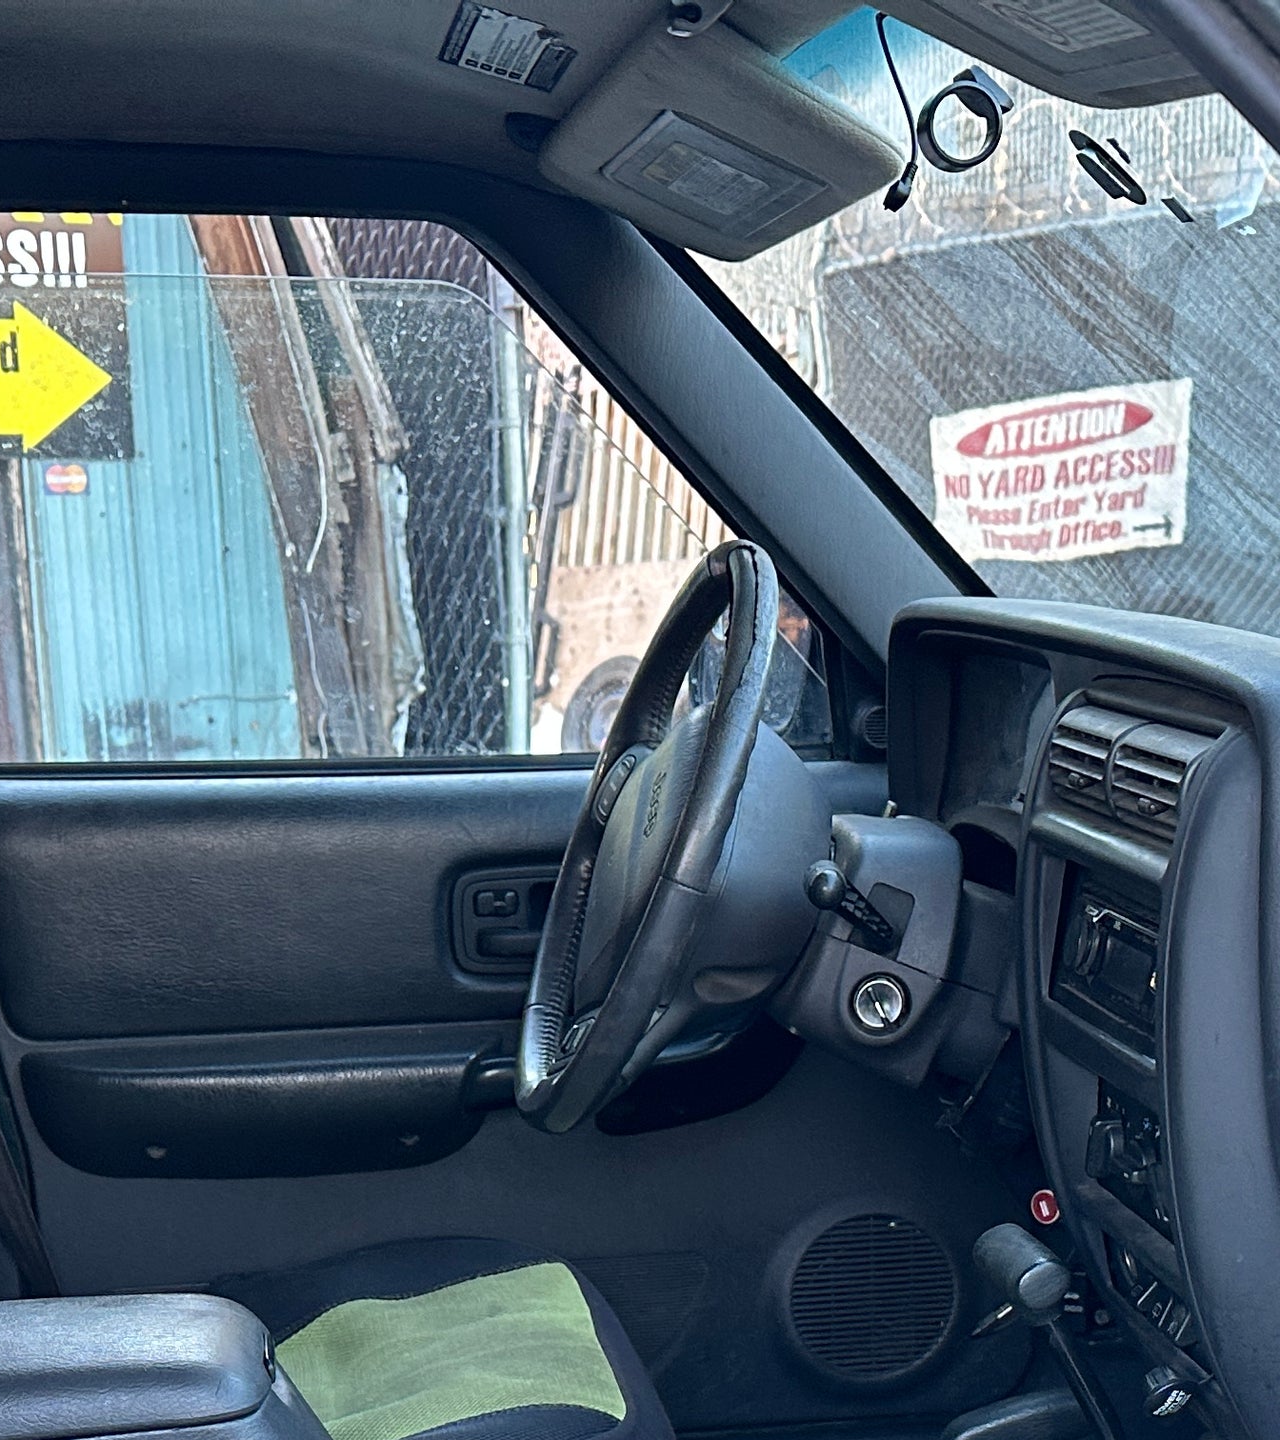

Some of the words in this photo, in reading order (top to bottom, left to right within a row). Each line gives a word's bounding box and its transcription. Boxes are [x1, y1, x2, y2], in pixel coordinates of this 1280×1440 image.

[983, 402, 1126, 456] ATTENTION
[944, 474, 970, 499] NO
[978, 464, 1046, 500] YARD
[1054, 444, 1176, 488] ACCESS!!!
[967, 504, 1022, 525] Please
[1027, 495, 1087, 525] Enter
[1093, 482, 1148, 513] Yard
[982, 529, 1052, 554] Through
